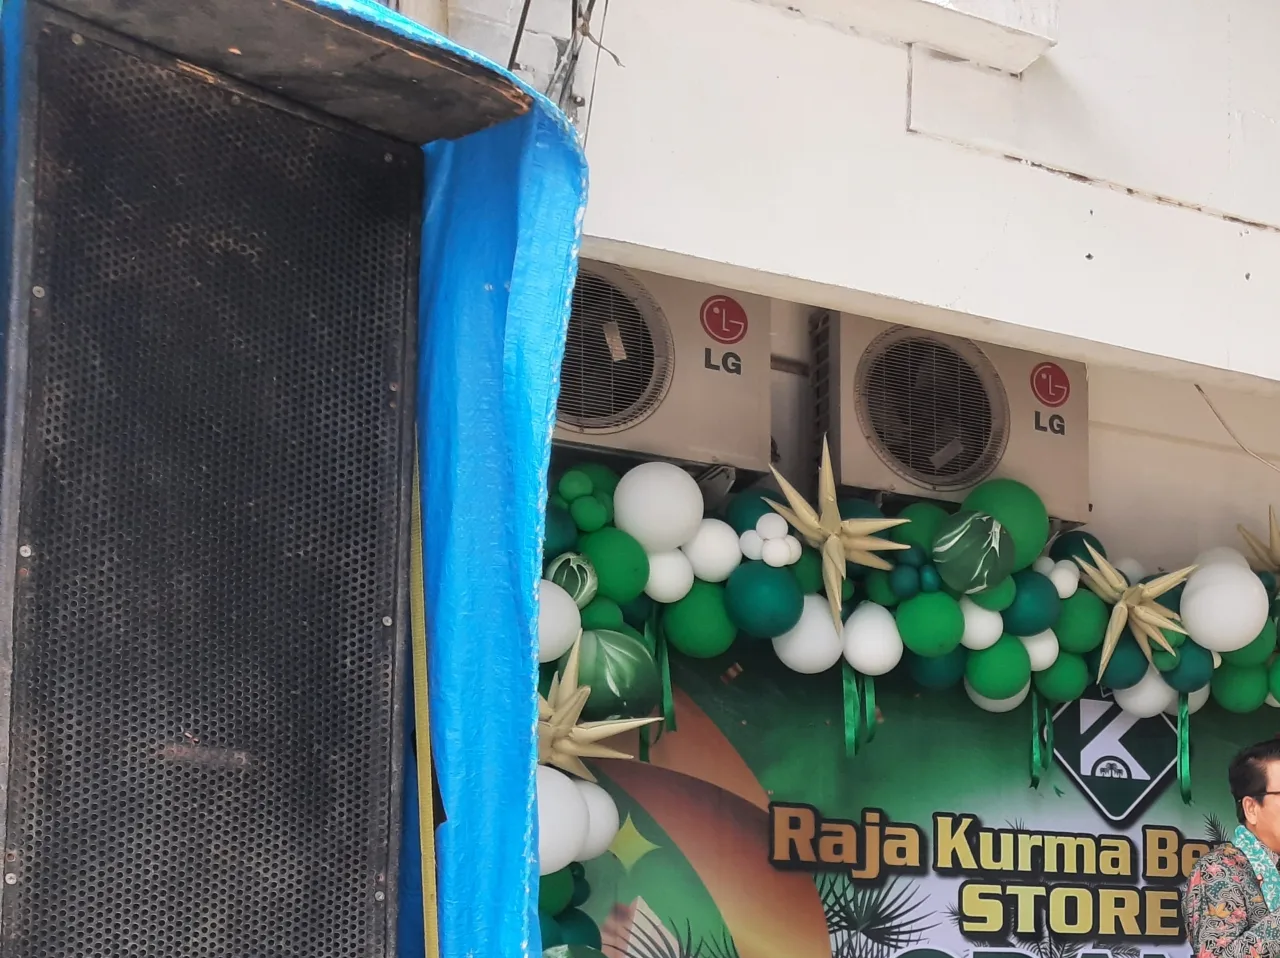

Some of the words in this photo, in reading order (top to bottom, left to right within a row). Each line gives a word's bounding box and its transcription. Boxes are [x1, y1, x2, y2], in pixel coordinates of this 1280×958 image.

[704, 348, 743, 376] LG
[1034, 411, 1065, 436] LG
[771, 804, 923, 881] Raja
[934, 813, 1134, 878] Kurma
[960, 883, 1182, 937] STORE
